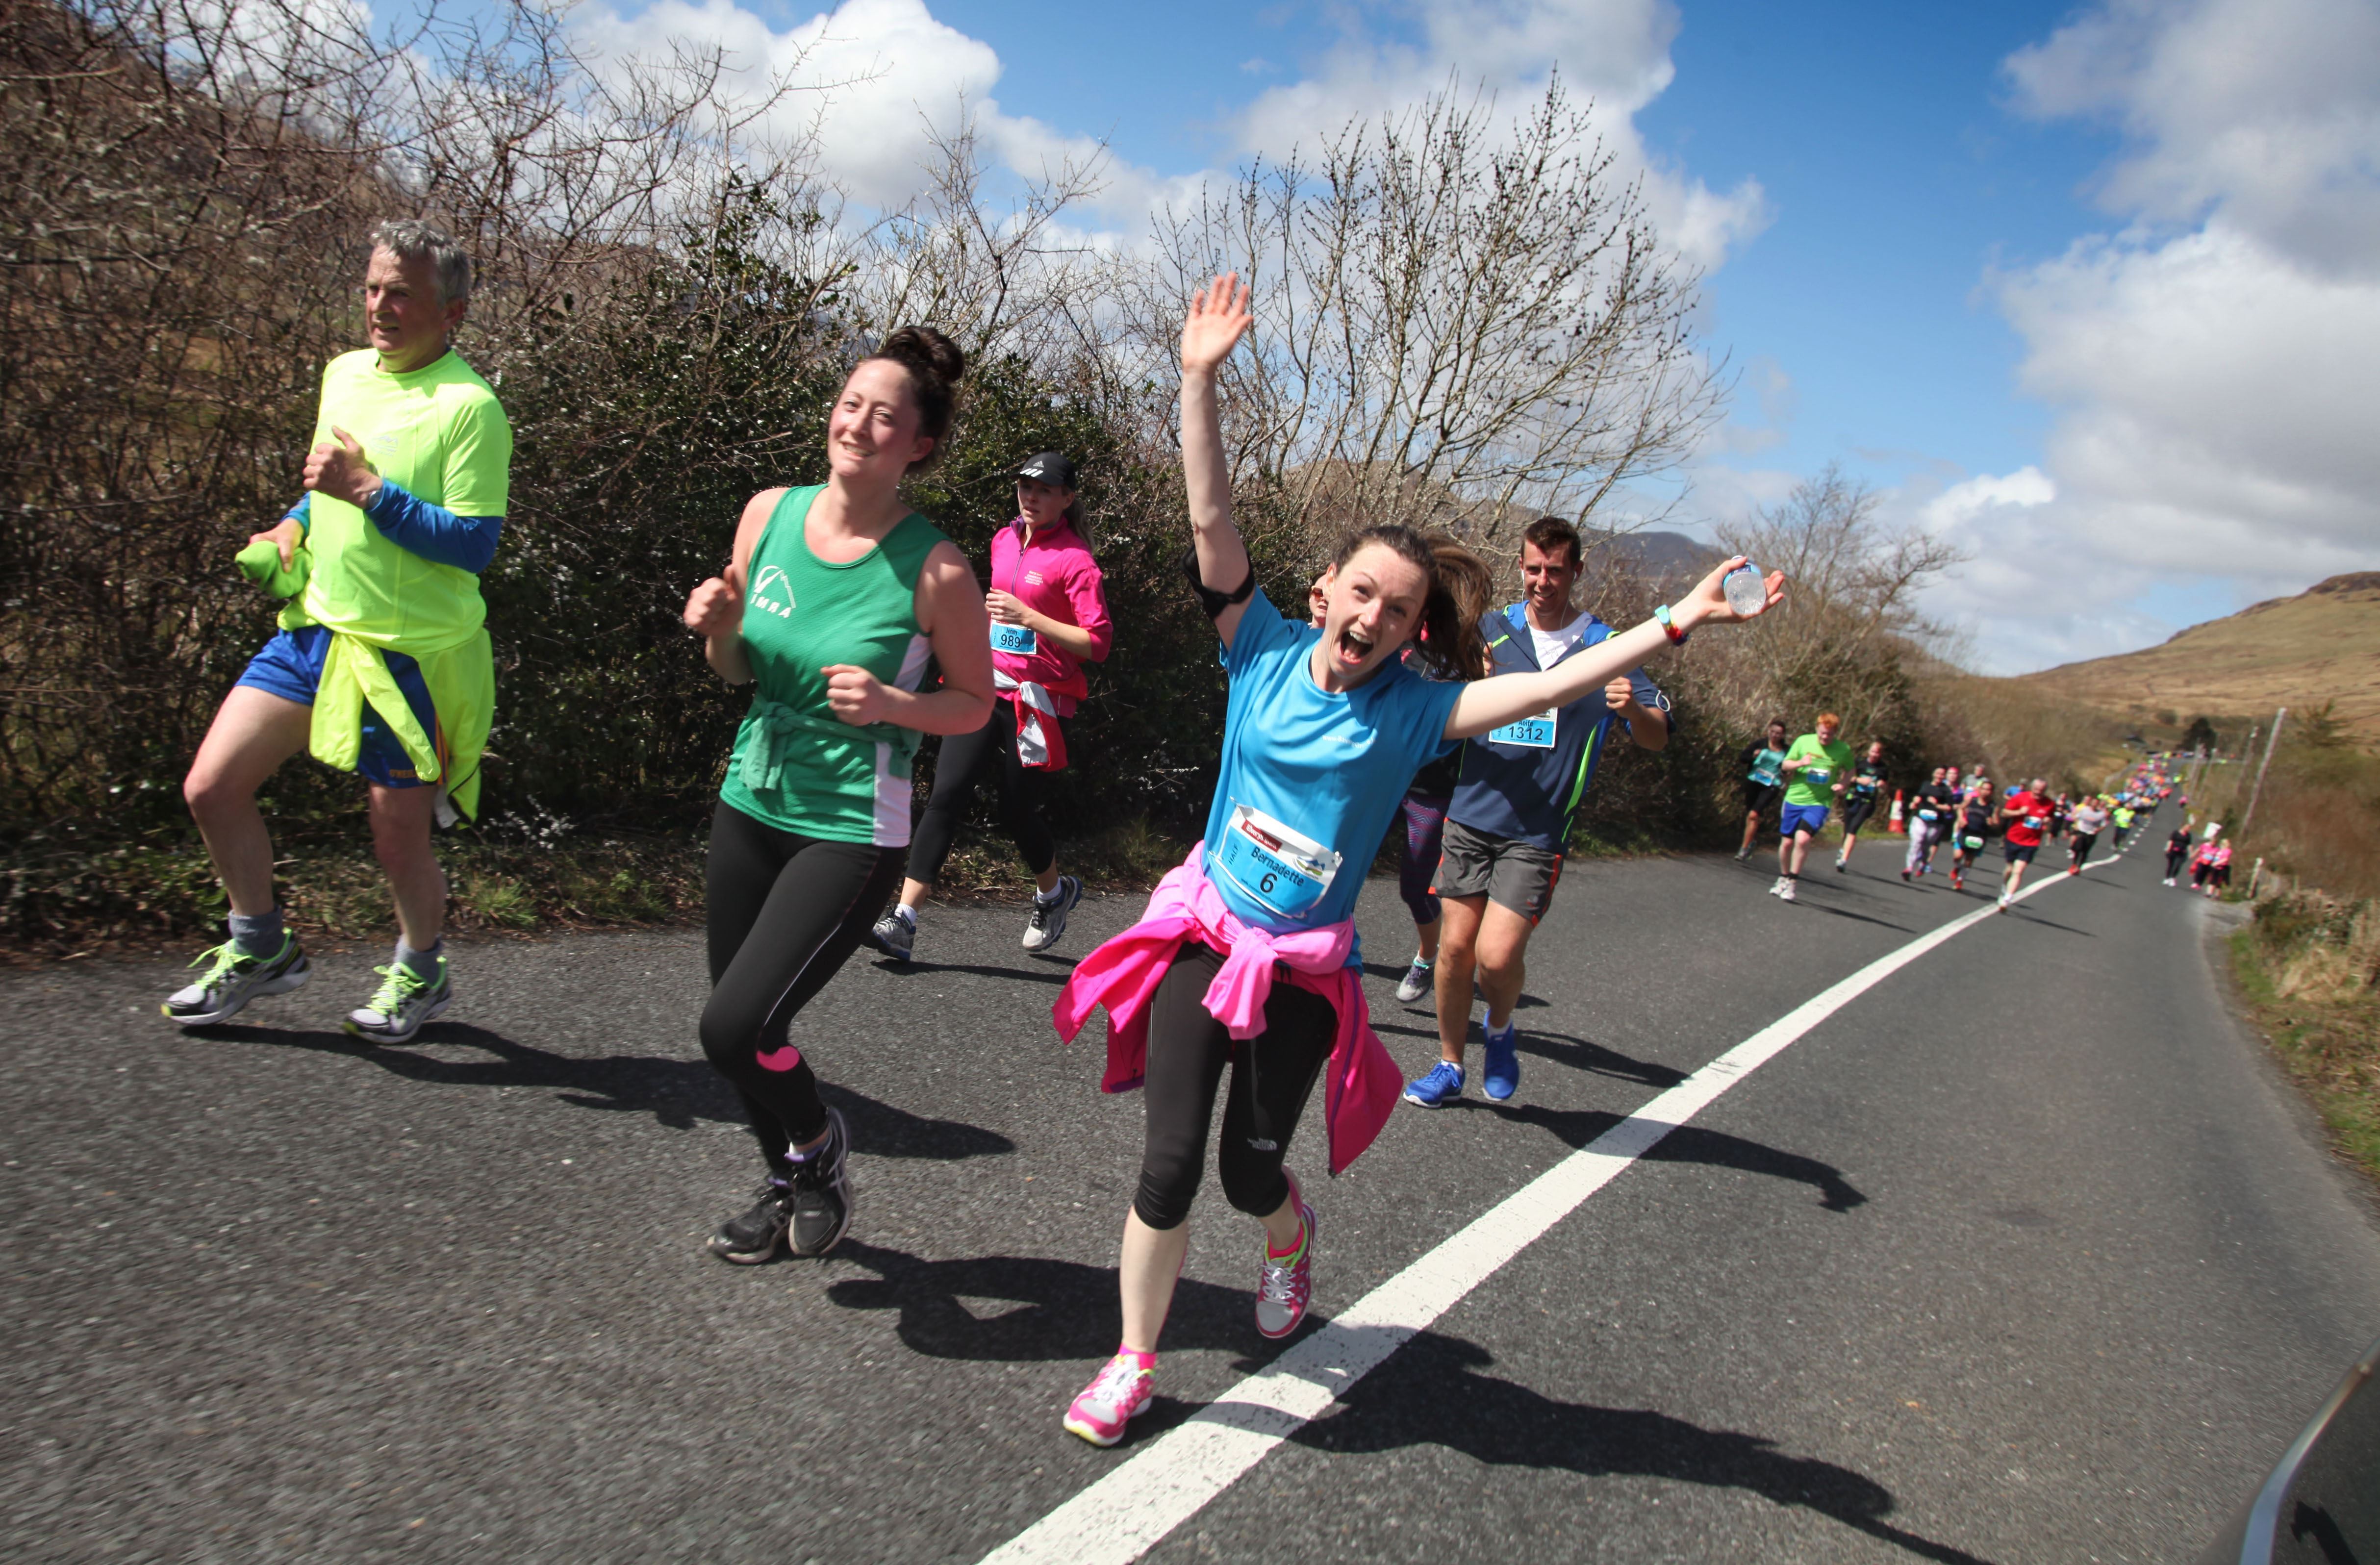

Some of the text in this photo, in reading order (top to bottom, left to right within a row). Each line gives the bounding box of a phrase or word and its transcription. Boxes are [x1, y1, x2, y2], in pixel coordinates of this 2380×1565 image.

[1005, 628, 1017, 636] Jenny
[1000, 634, 1020, 648] 989
[1509, 726, 1543, 740] 1312
[1228, 843, 1239, 865] HALF
[1251, 846, 1304, 887] Bernadette
[1260, 872, 1278, 893] 6
